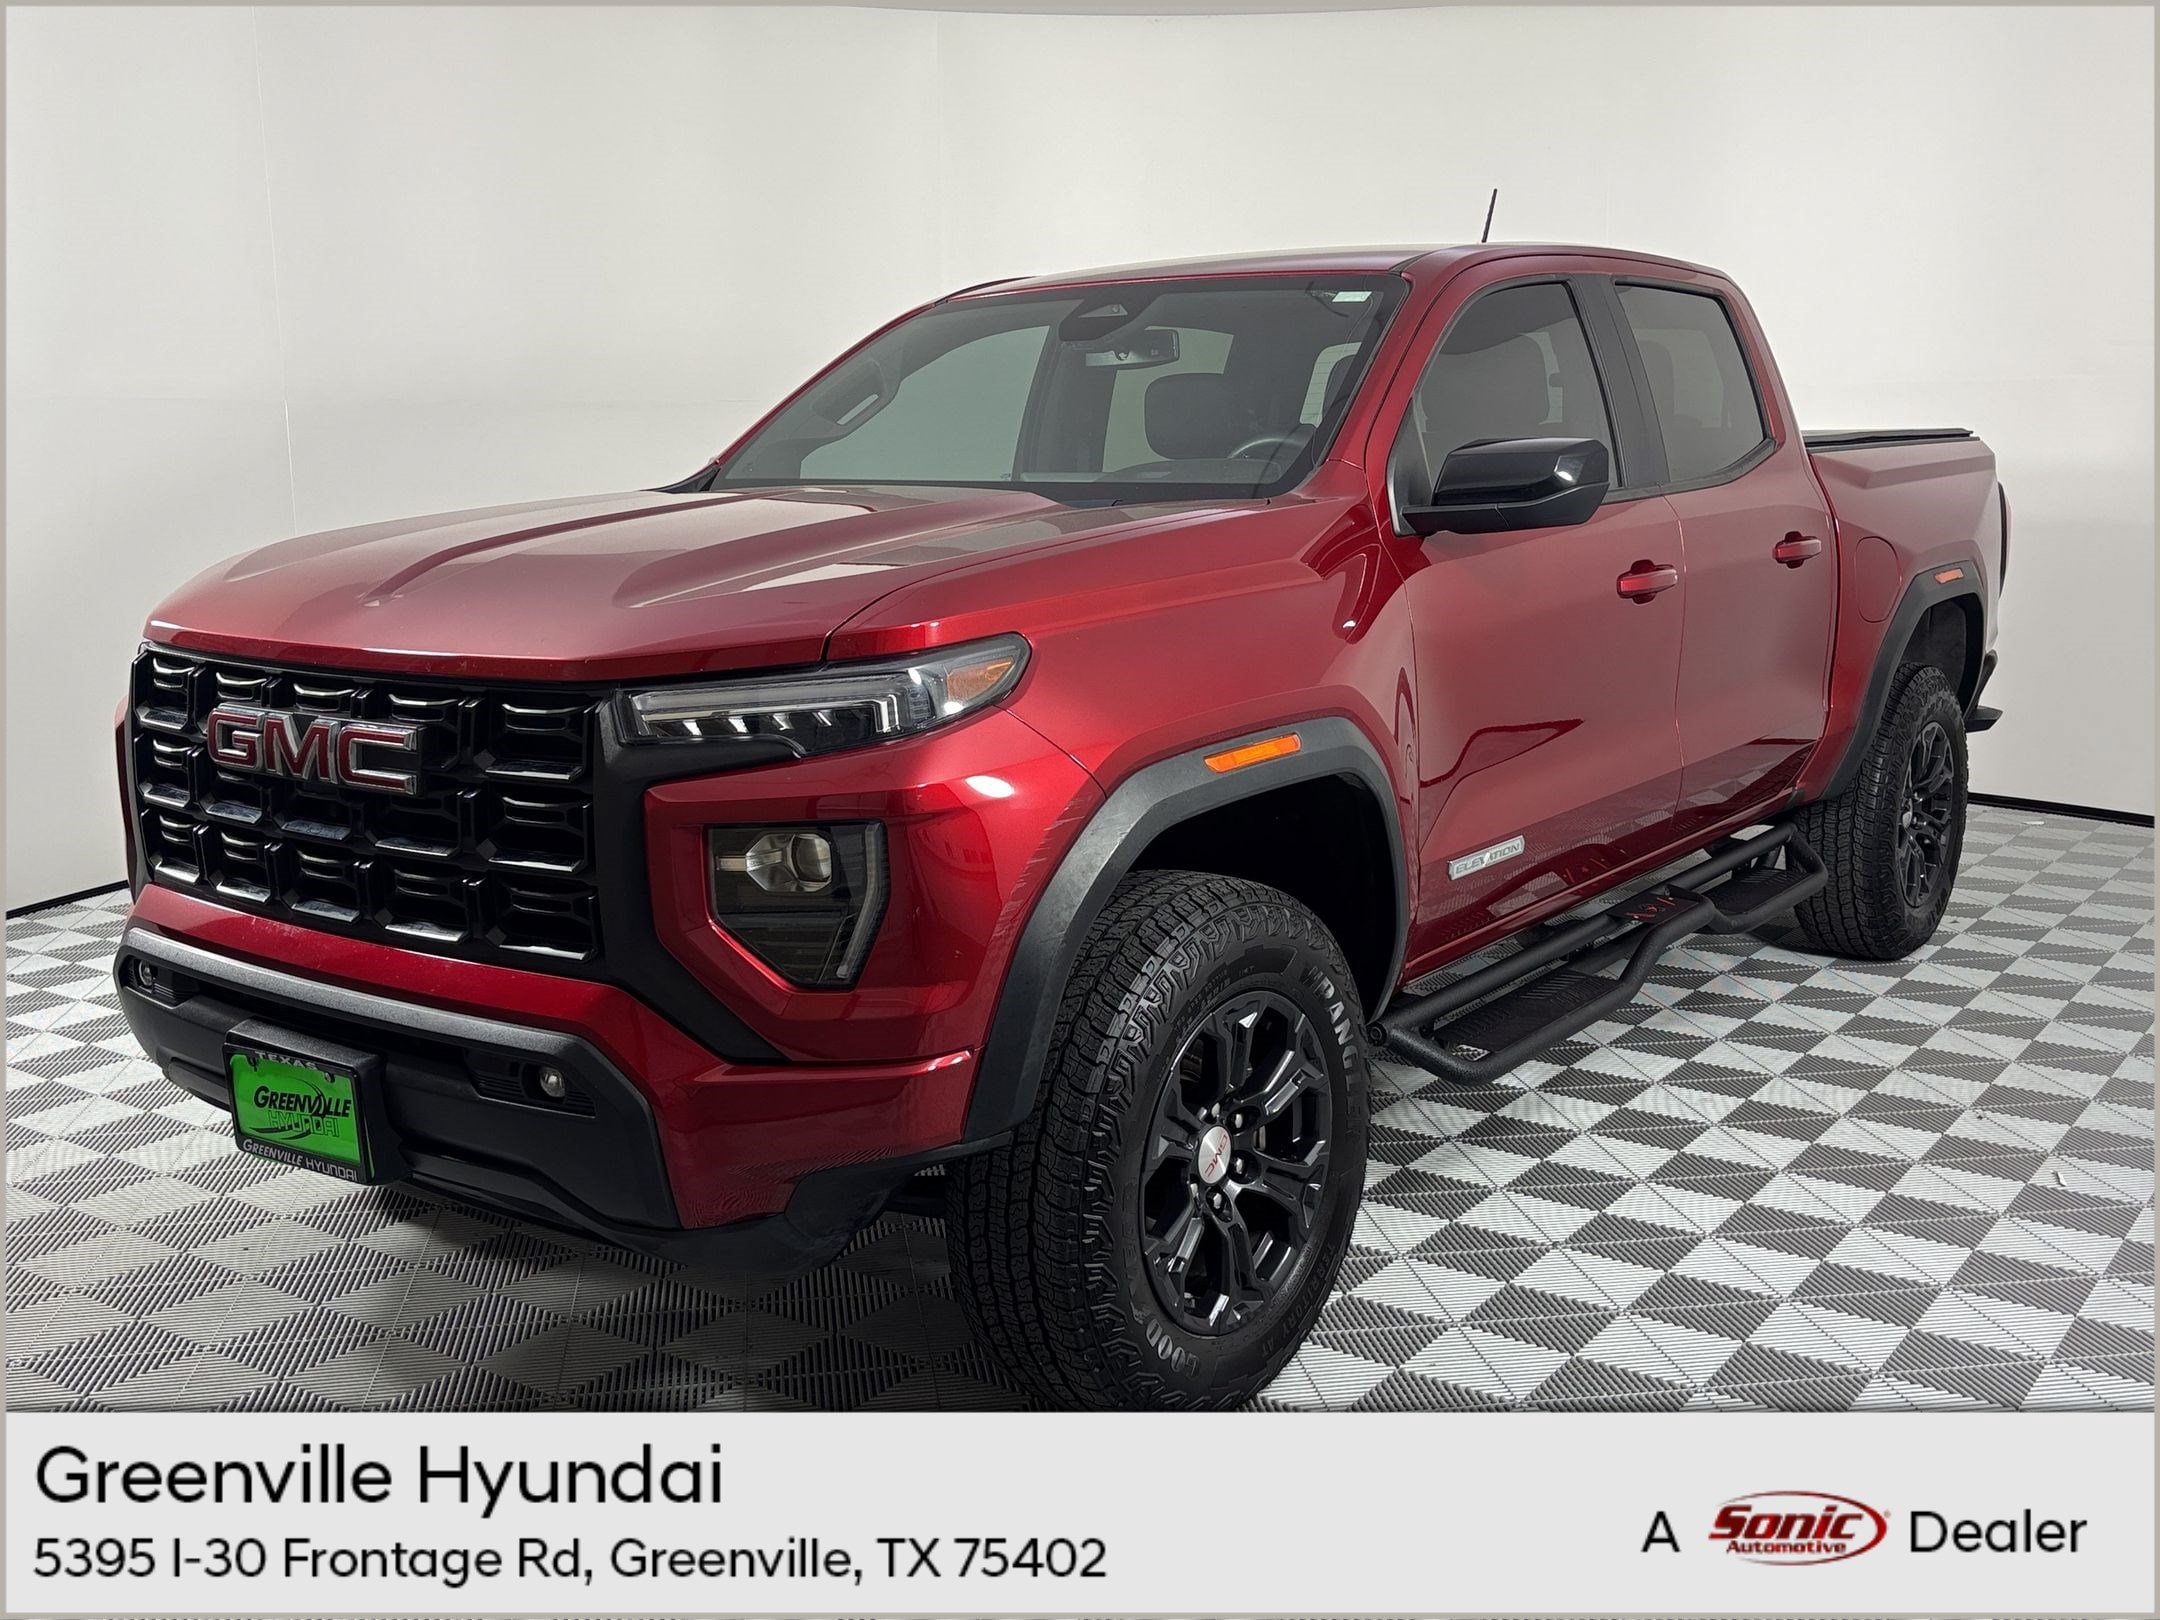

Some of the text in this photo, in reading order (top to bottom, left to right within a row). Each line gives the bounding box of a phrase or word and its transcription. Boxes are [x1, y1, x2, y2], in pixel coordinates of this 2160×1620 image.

[207, 703, 418, 796] GMC
[1455, 842, 1520, 875] ELEVATION
[254, 1051, 318, 1071] TEXAS
[267, 1109, 341, 1138] HYUNDAI
[242, 1138, 358, 1182] GREENVILLE HYUNDAI
[1204, 1134, 1228, 1177] GMC
